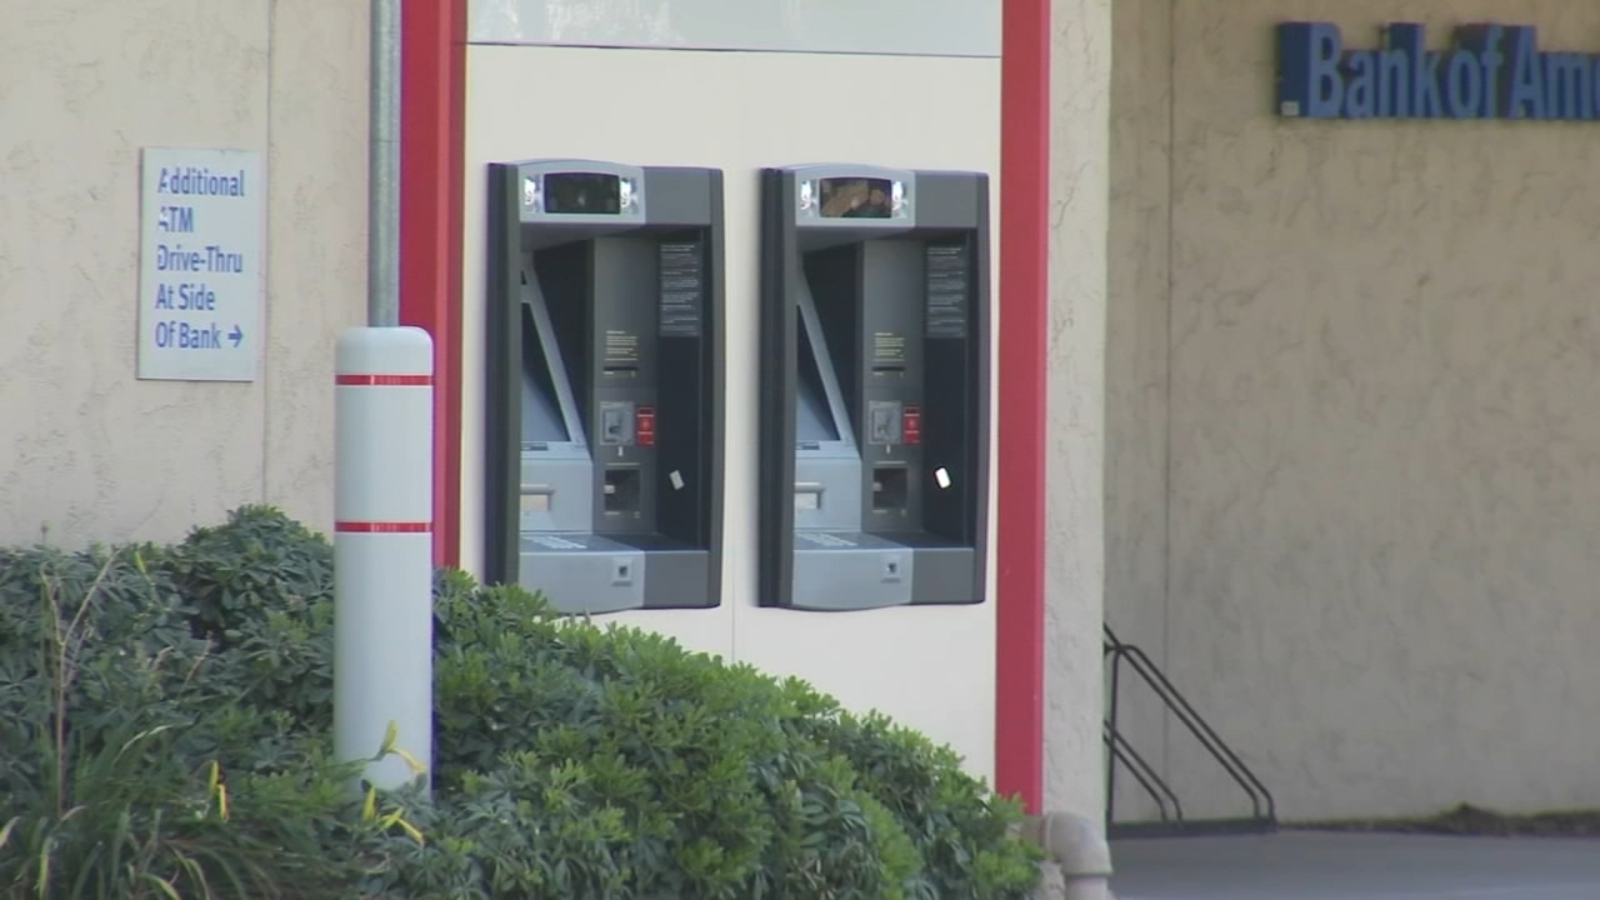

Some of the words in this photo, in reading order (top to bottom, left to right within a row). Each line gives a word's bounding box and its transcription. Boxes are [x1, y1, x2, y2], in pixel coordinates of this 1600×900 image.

[1305, 22, 1441, 118] Bank
[1448, 24, 1505, 118] of
[1508, 25, 1600, 119] Am
[158, 168, 245, 197] Additional
[157, 244, 243, 273] Drive-Thru
[155, 284, 174, 310] At
[178, 284, 215, 311] Side
[155, 321, 176, 348] Of
[178, 322, 221, 349] Bank
